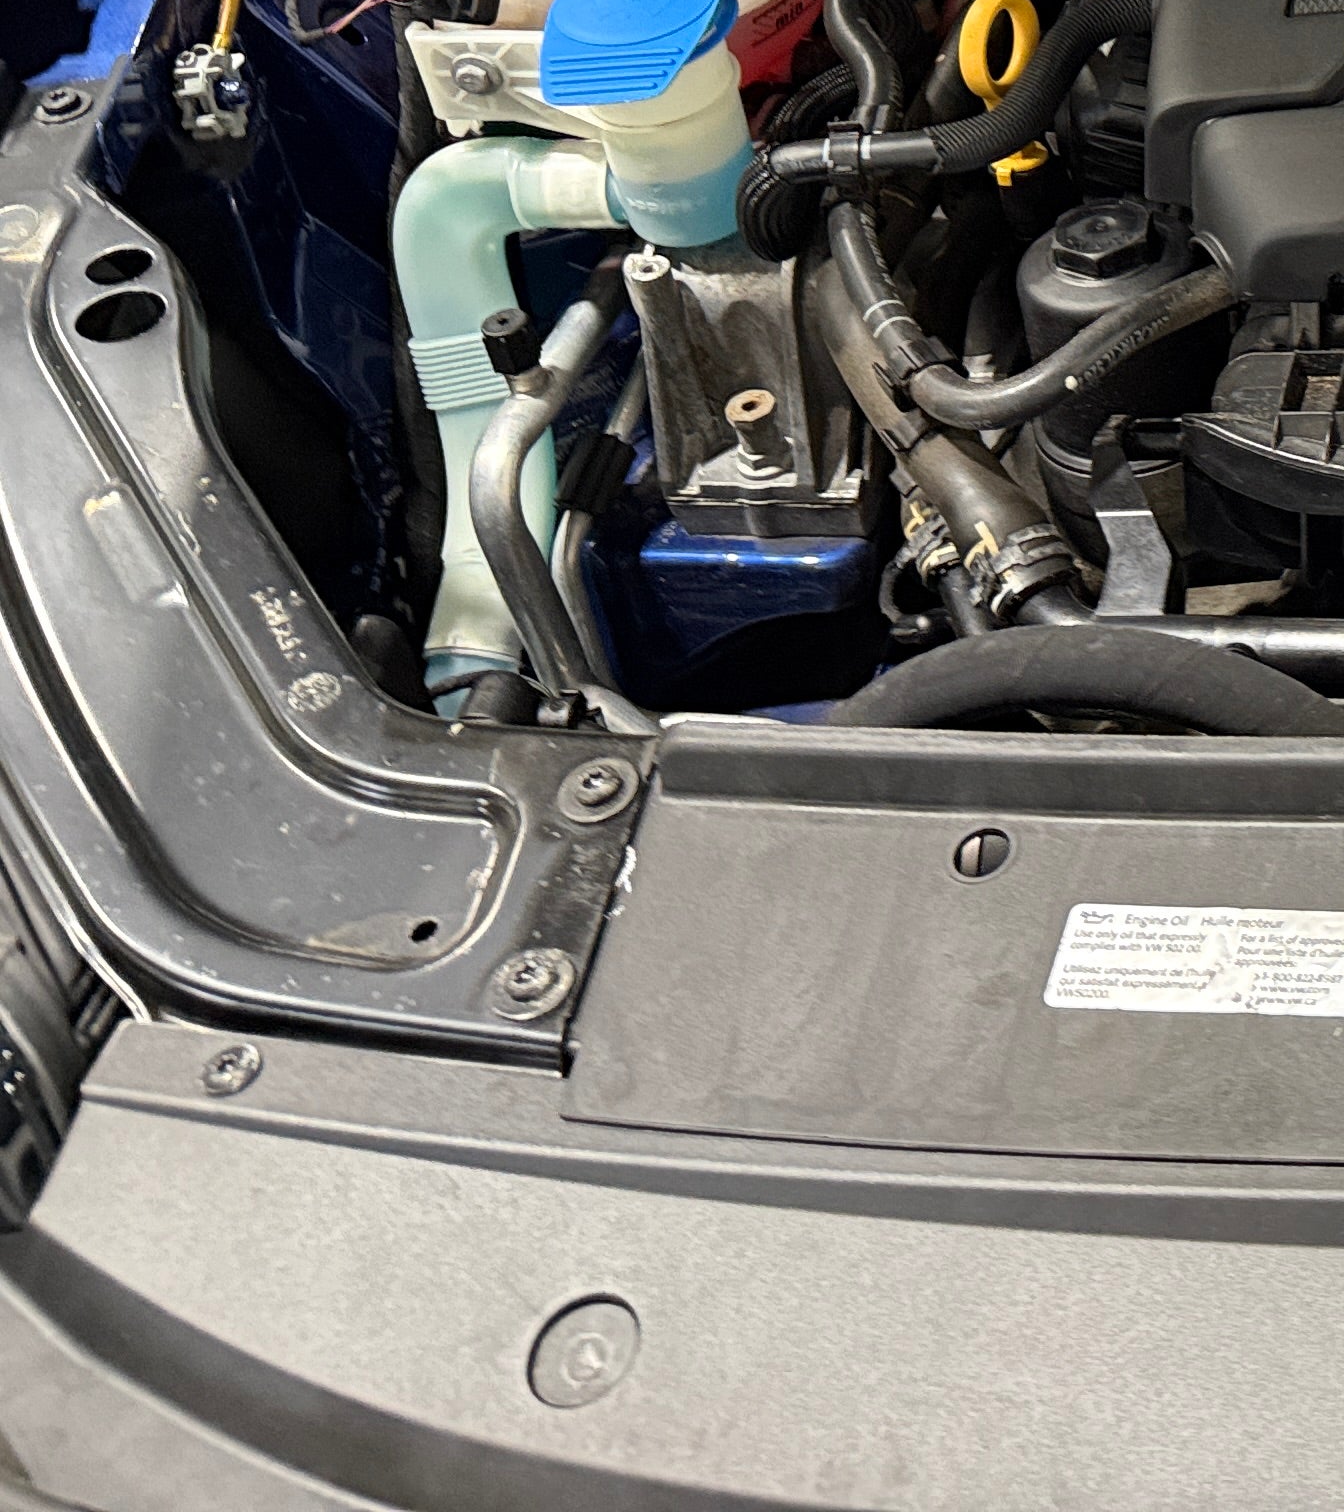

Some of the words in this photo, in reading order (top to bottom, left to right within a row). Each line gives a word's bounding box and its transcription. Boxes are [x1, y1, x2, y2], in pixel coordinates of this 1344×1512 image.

[1125, 914, 1168, 928] Engine
[1171, 915, 1189, 926] Oil
[1074, 929, 1094, 938] Use
[1096, 930, 1118, 940] only
[1120, 930, 1134, 938] oil
[1135, 931, 1157, 940] that
[1159, 932, 1208, 943] expressly
[1240, 934, 1258, 943] For
[1268, 934, 1284, 944] list
[1286, 935, 1299, 944] of
[1070, 942, 1116, 951] complies
[1119, 943, 1142, 951] with
[1145, 944, 1162, 952] VW
